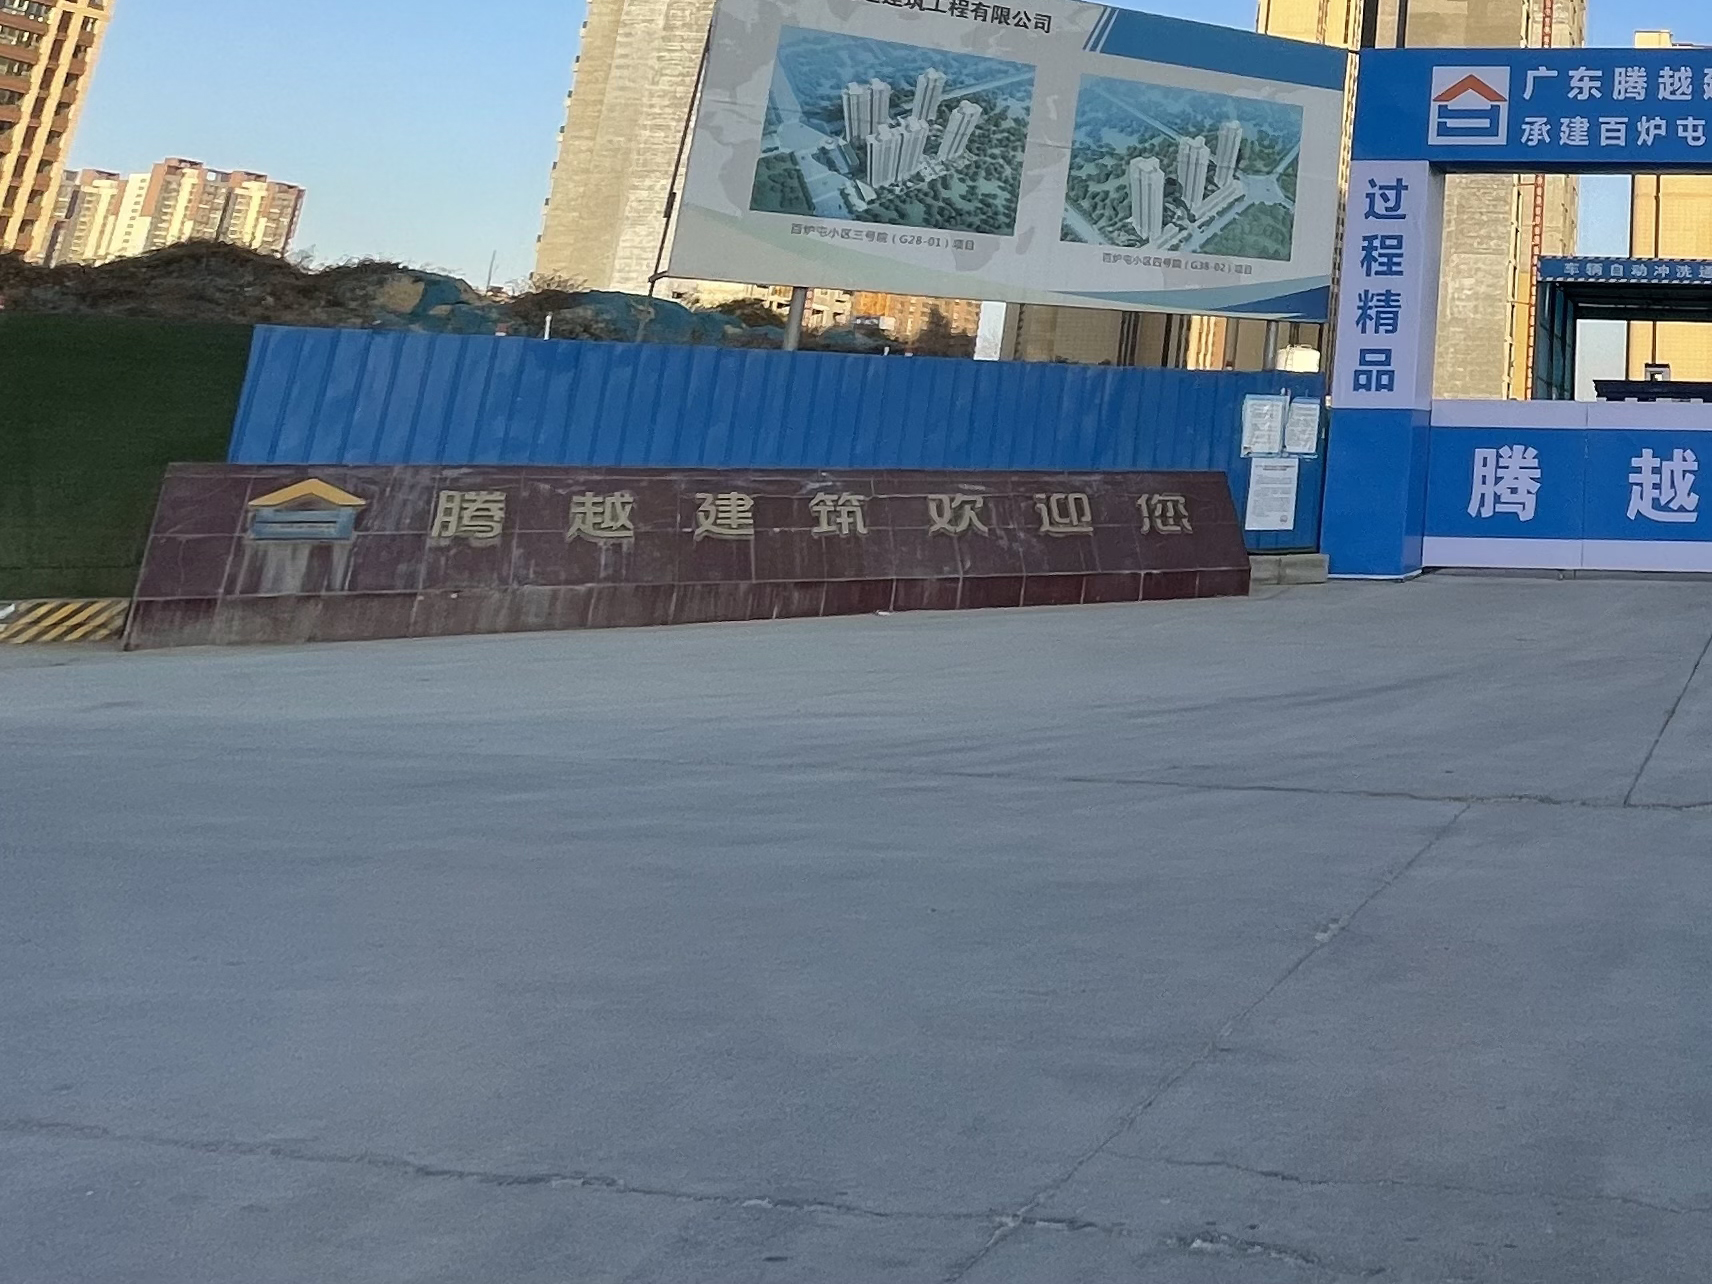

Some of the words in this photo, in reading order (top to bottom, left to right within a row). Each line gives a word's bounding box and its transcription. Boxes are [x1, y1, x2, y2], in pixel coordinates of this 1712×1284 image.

[1352, 177, 1408, 394] 过程精品
[431, 489, 1193, 541] 腾越建筑欢迎您
